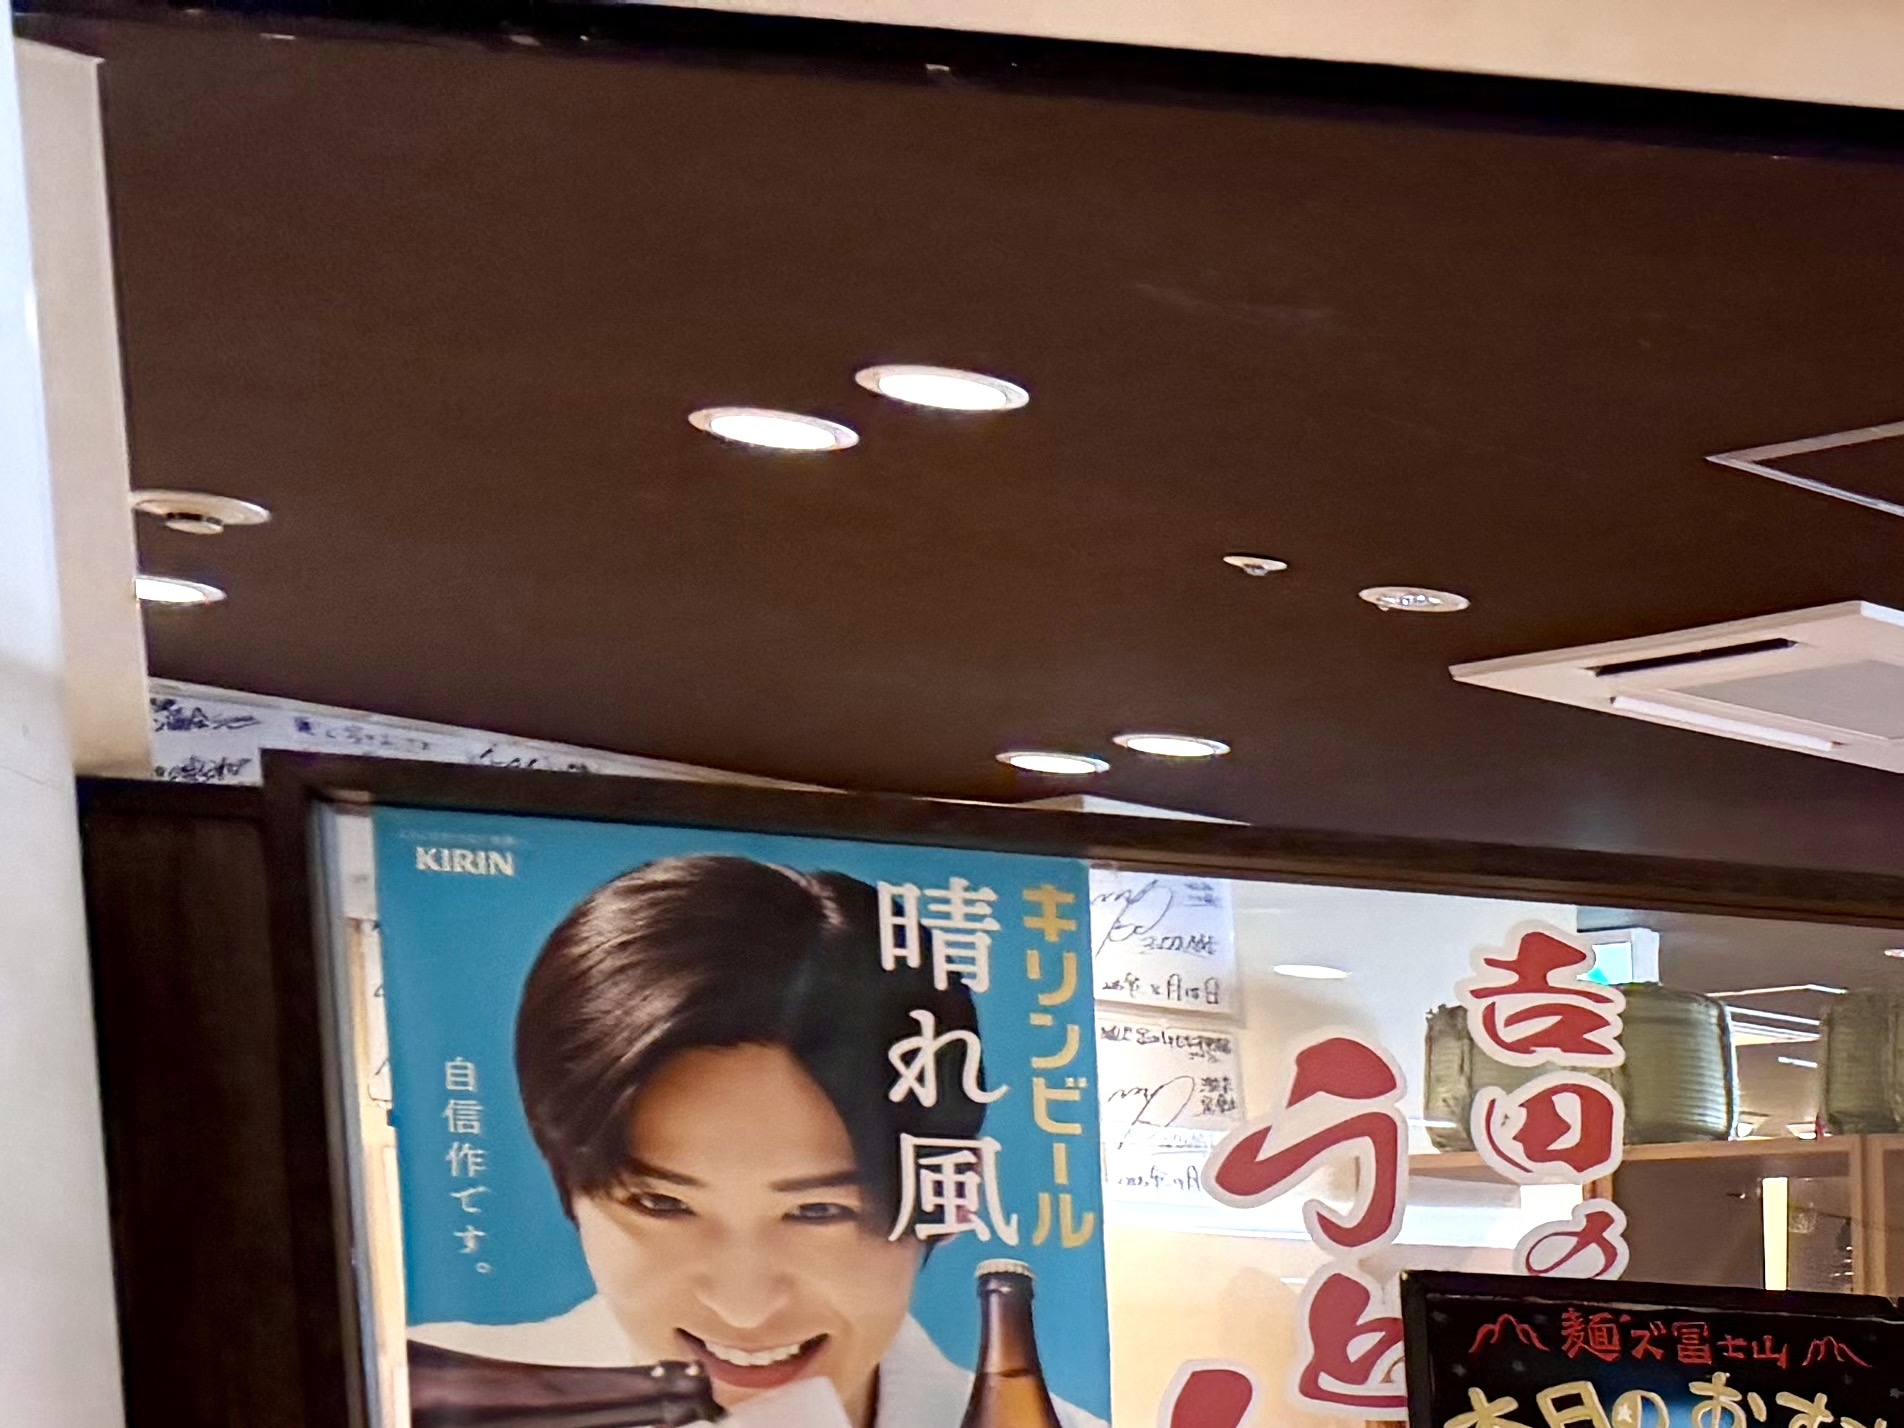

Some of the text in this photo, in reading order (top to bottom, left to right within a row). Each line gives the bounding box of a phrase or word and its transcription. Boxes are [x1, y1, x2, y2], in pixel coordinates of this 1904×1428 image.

[414, 847, 515, 877] KIRIN
[443, 1057, 492, 1276] 自信作です。
[876, 880, 1018, 1246] 晴れ風
[1022, 884, 1093, 1247] キリンビール
[1470, 932, 1626, 1278] 吉田の
